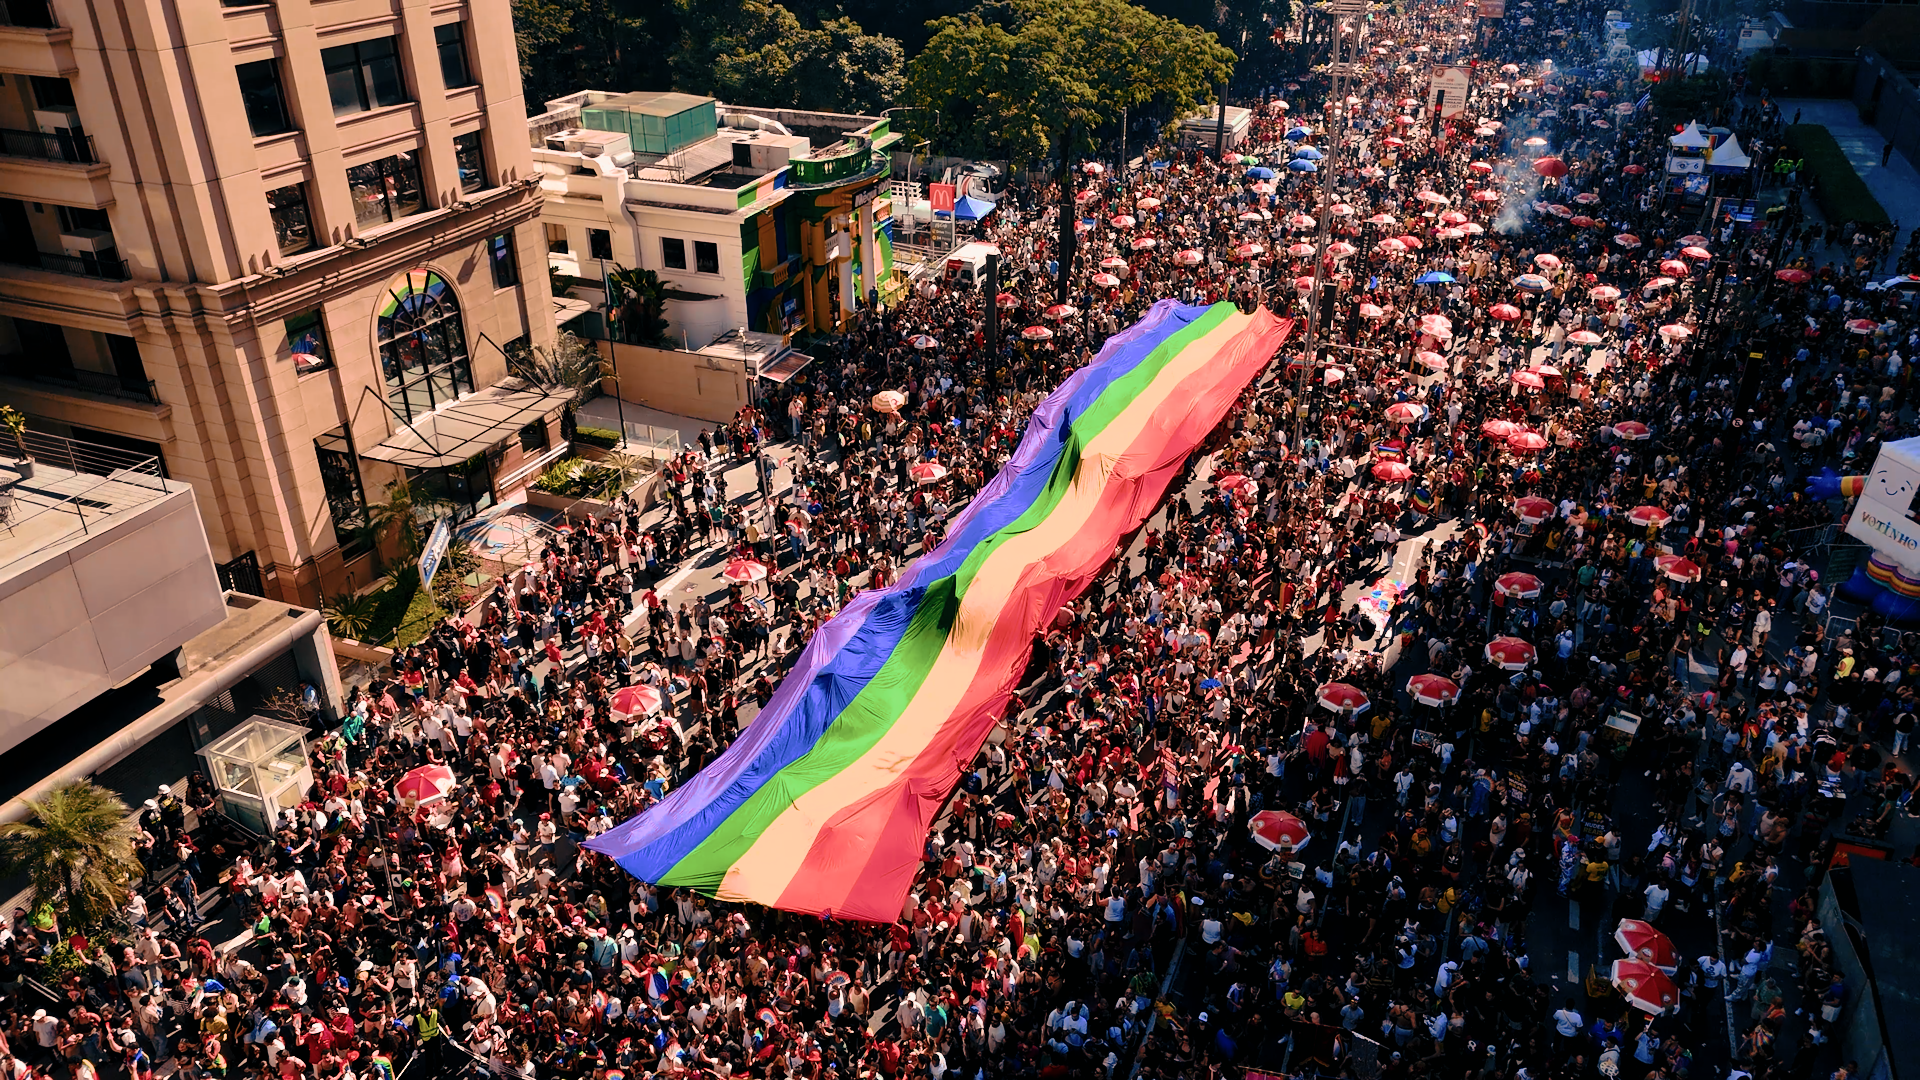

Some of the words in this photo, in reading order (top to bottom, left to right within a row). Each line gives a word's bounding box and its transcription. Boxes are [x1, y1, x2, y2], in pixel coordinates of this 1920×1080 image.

[1360, 236, 1369, 260] Caneca
[1704, 307, 1714, 325] Rocha
[1710, 278, 1722, 304] Azevedo
[1862, 511, 1918, 550] VOTINHO
[1584, 821, 1605, 830] NUDES
